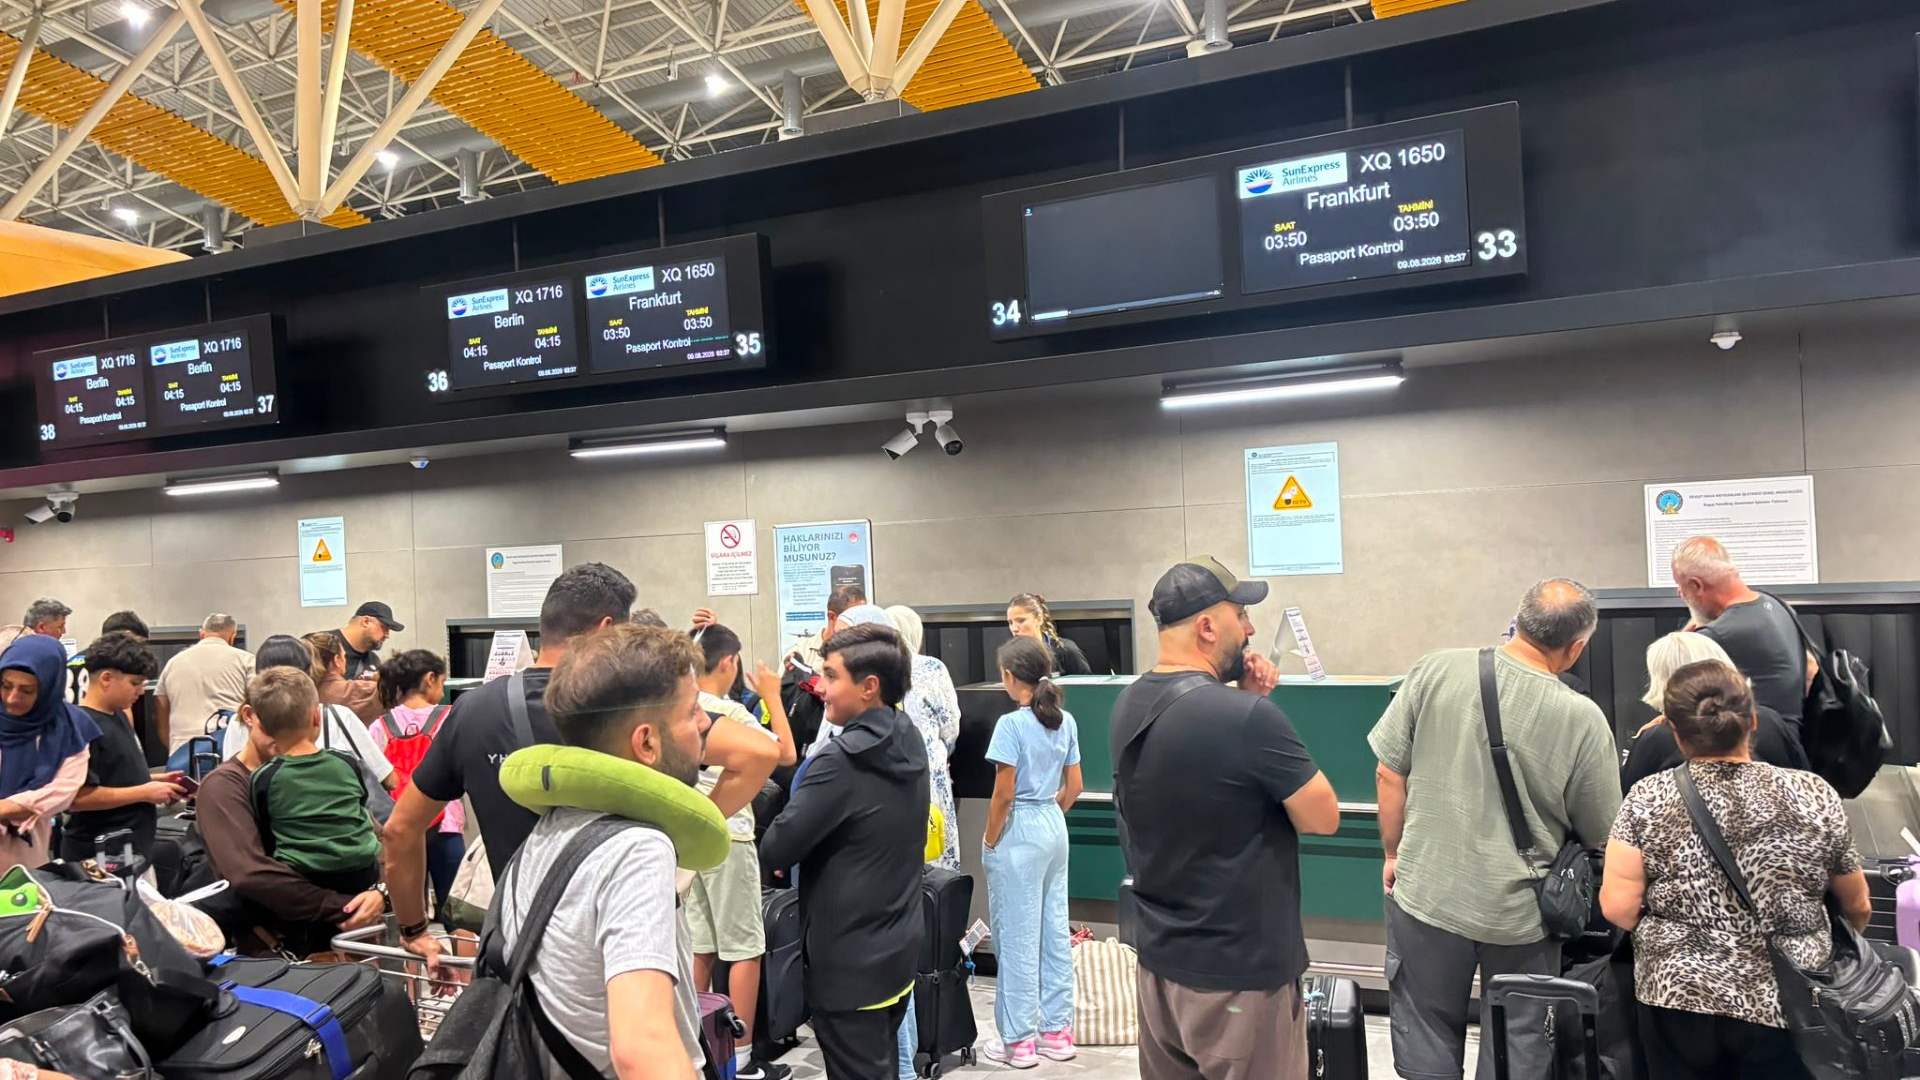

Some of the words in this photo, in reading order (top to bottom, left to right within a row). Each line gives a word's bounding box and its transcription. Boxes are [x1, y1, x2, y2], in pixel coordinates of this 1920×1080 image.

[1360, 152, 1392, 173] XQ
[1398, 142, 1446, 166] 1650
[1282, 161, 1340, 176] SunExpress
[1282, 174, 1318, 187] Airlines
[1307, 182, 1391, 210] Frankfurt
[1398, 200, 1434, 214] TAHMİNİ
[1274, 221, 1296, 232] SAAT
[1394, 212, 1440, 232] 03:50
[1264, 230, 1308, 250] 03:50
[1478, 230, 1517, 260] 33
[1300, 247, 1356, 266] Pasaport
[1358, 240, 1404, 258] Kontrol
[612, 272, 650, 284] SunExpress
[662, 267, 682, 284] XQ
[685, 262, 715, 280] 1650
[515, 289, 534, 304] XQ
[536, 285, 563, 301] 1716
[613, 282, 636, 291] Airlines
[629, 291, 682, 310] Frankfurt
[992, 300, 1021, 325] 34
[494, 313, 524, 329] Berlin
[684, 316, 712, 331] 03:50
[603, 327, 630, 341] 03:50
[204, 342, 218, 354] XQ
[220, 337, 242, 352] 1716
[535, 335, 561, 350] 04:15
[626, 342, 661, 354] Pasaport
[662, 337, 691, 350] Kontrol
[736, 332, 760, 356] 35
[463, 344, 488, 358] 04:15
[101, 357, 114, 370] XQ
[188, 362, 212, 375] Berlin
[484, 358, 516, 372] Pasaport
[516, 355, 542, 368] Kontrol
[86, 376, 109, 390] Berlin
[220, 381, 242, 392] 04:15
[428, 371, 448, 392] 36
[258, 394, 274, 413] 37
[40, 424, 56, 440] 38
[784, 532, 843, 544] HAKLARINIZI
[784, 543, 820, 552] BİLİYOR
[784, 552, 836, 562] MUSUNUZ?
